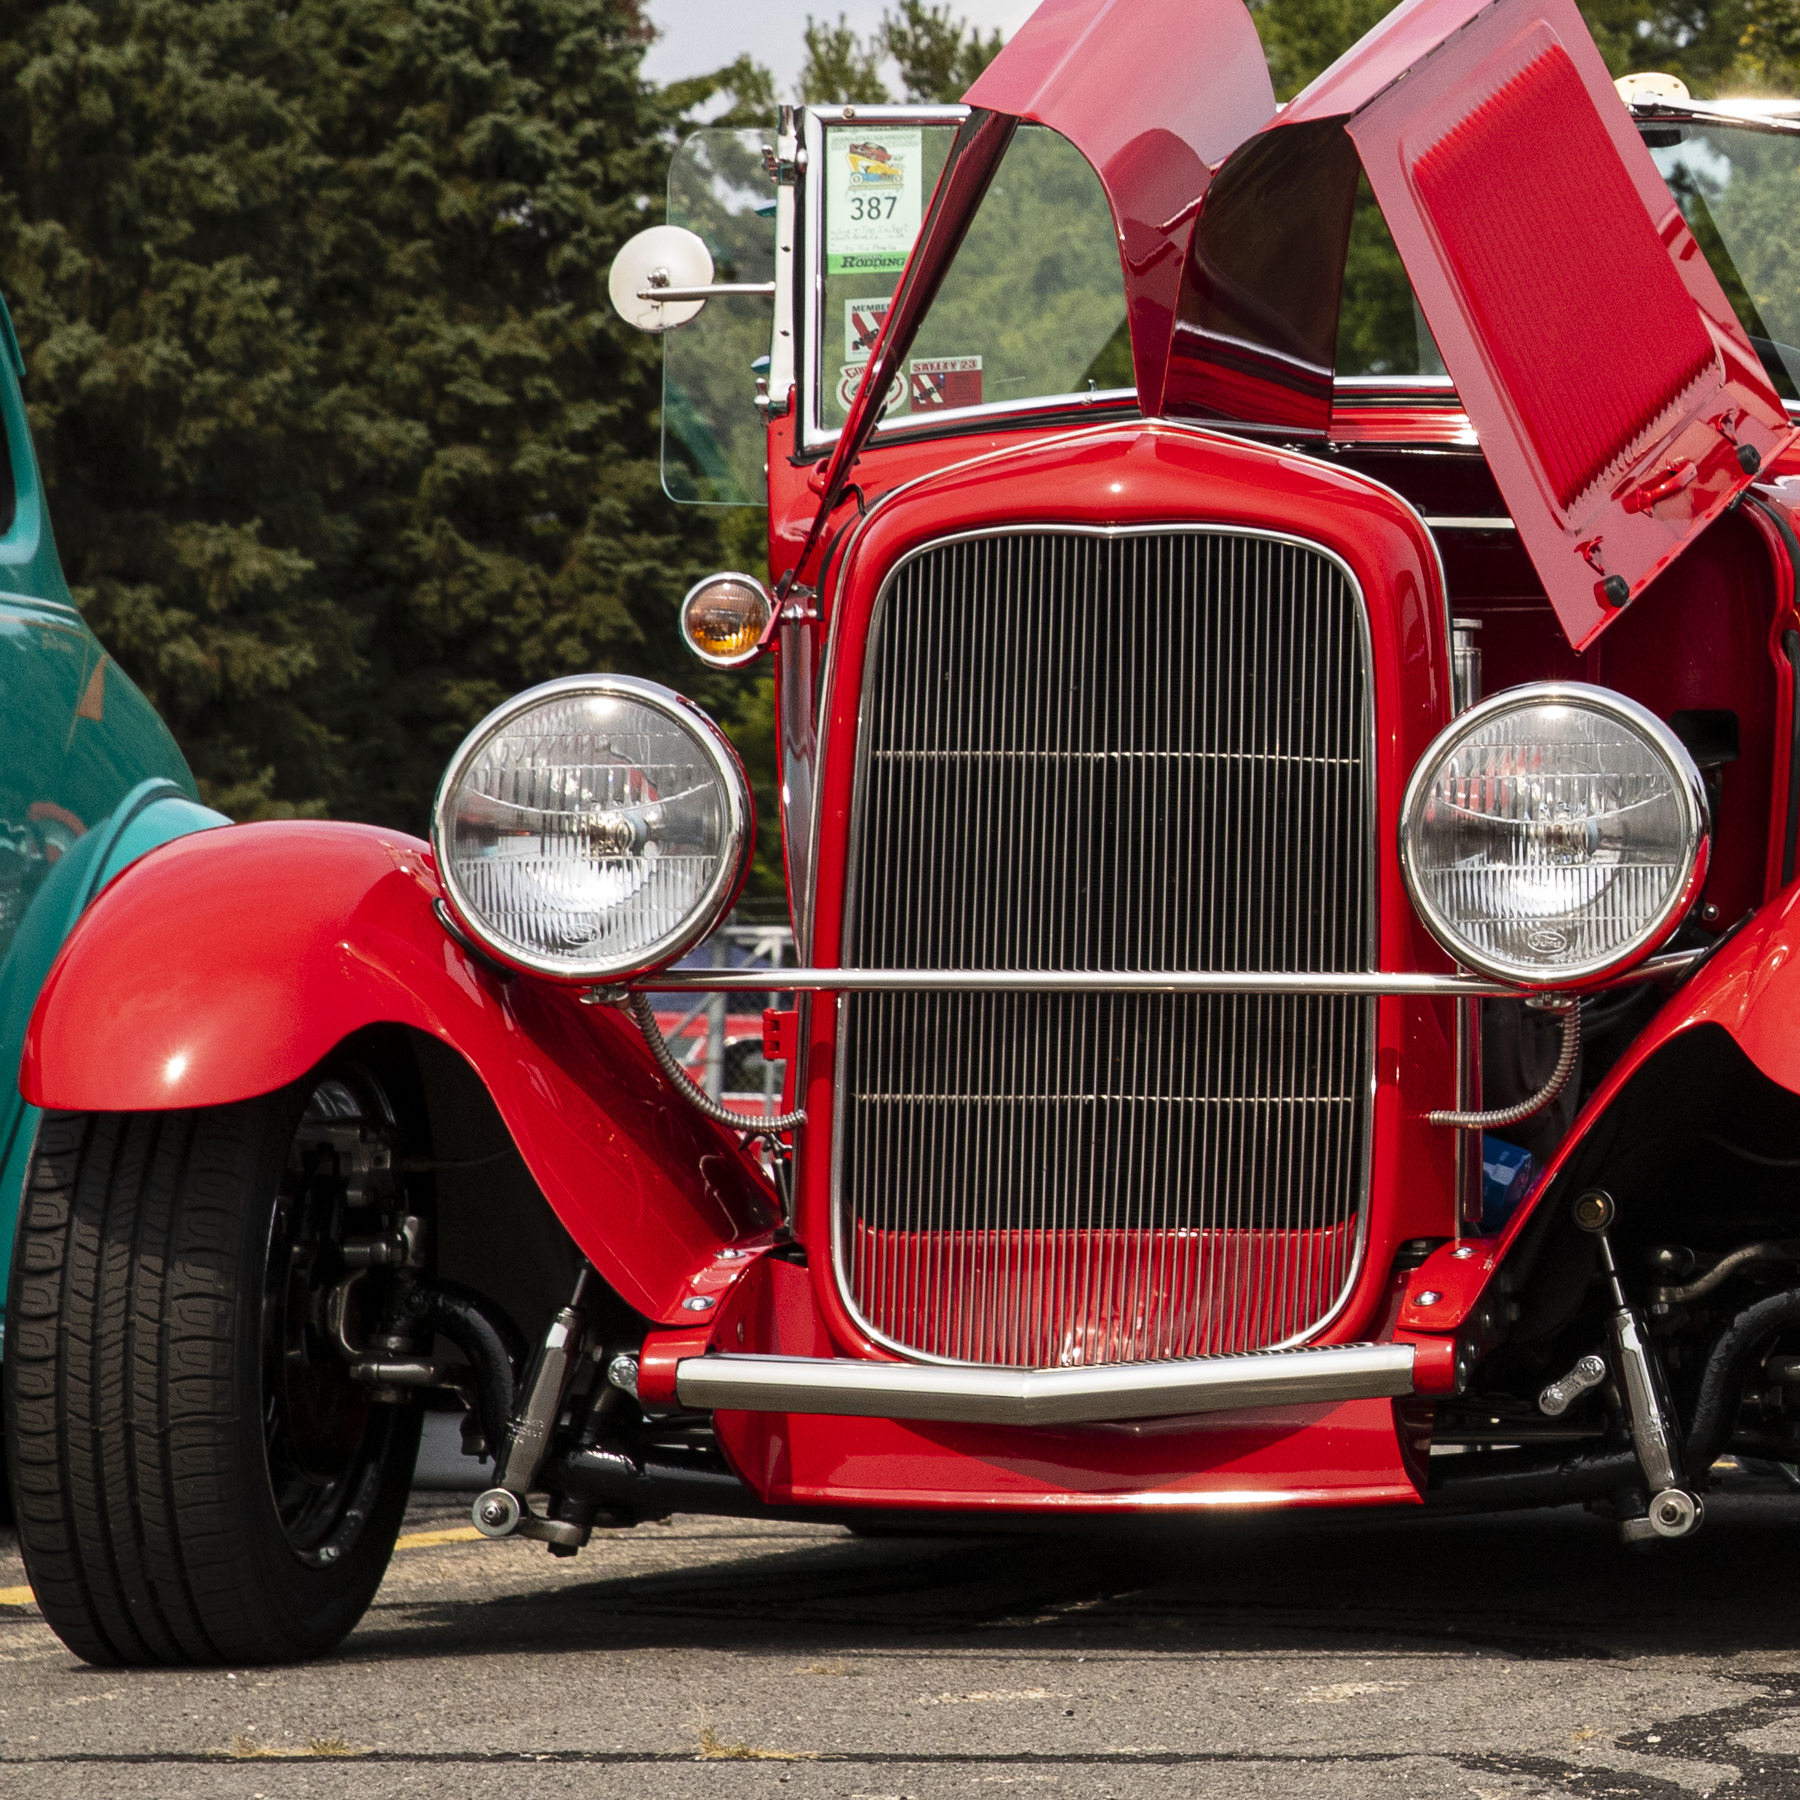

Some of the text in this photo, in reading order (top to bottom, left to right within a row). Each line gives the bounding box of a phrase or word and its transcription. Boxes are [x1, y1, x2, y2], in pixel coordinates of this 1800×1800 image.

[850, 196, 897, 221] 387
[841, 256, 905, 269] RODDING
[961, 359, 977, 369] 23
